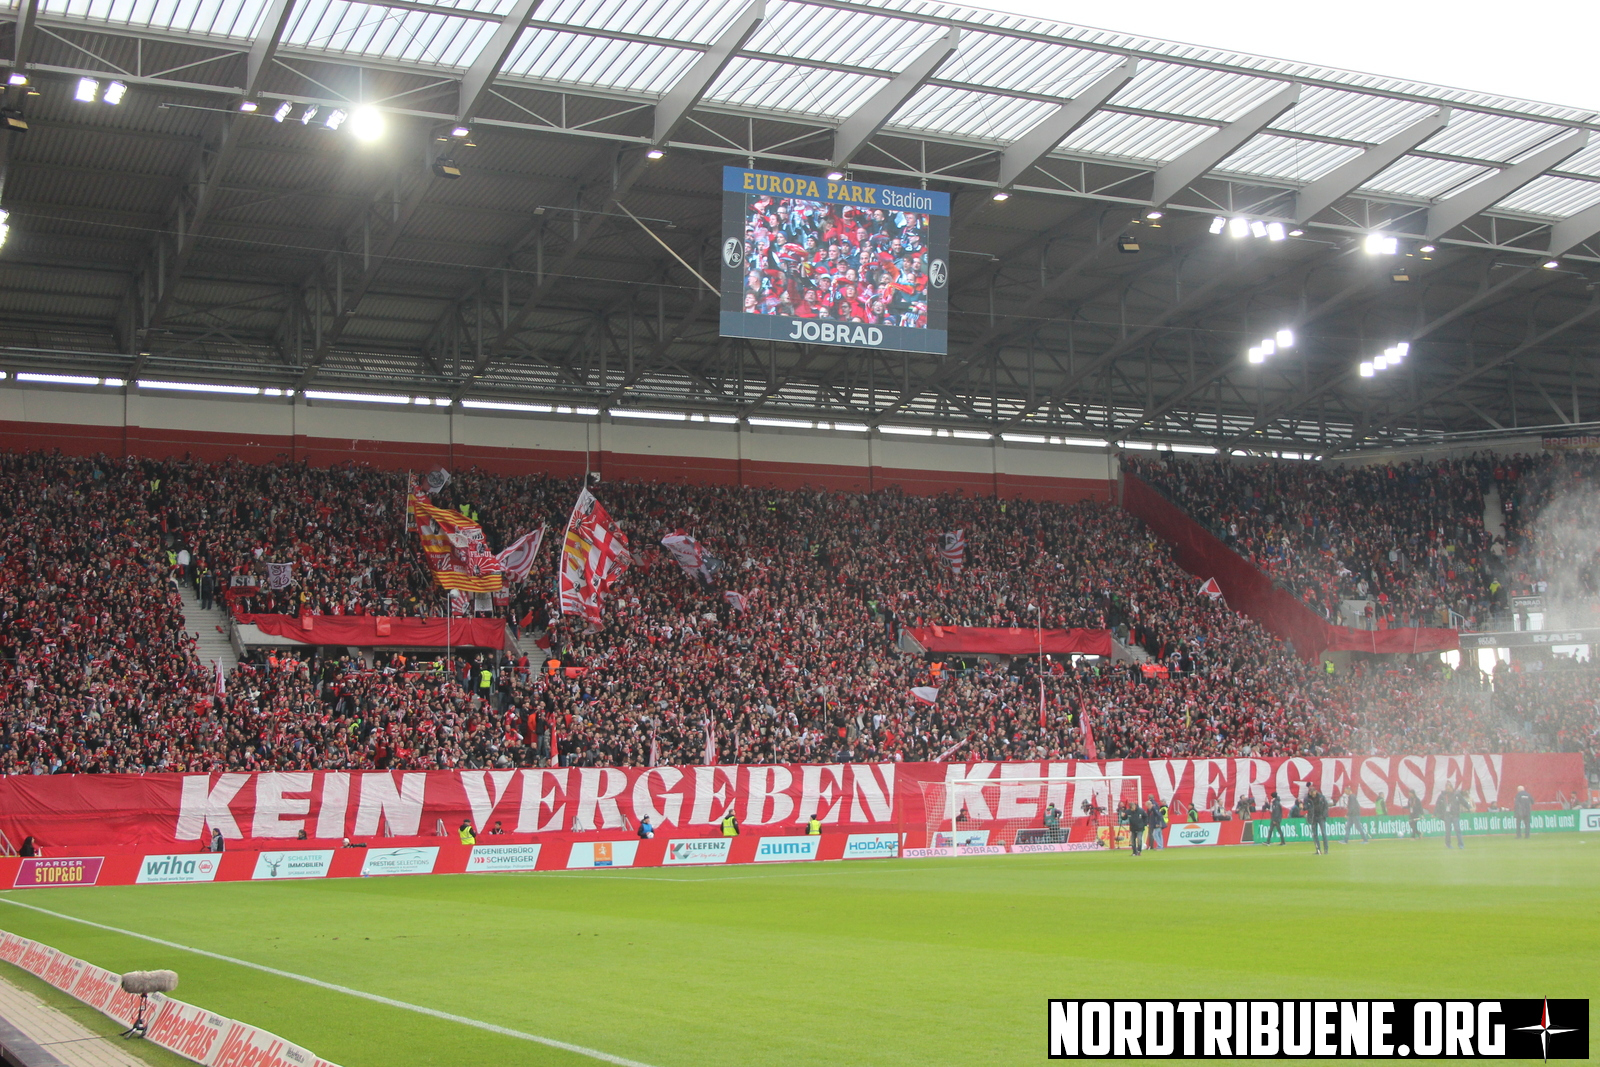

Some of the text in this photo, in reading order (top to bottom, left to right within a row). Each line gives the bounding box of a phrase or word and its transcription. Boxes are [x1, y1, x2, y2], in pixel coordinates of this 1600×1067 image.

[743, 172, 932, 211] EUROPA PARK Stadion
[789, 320, 883, 346] JOBRAD
[174, 754, 1503, 840] KEIN VERGEBEN KEIN VERGESSEN
[1473, 817, 1488, 830] BAU
[1490, 816, 1500, 829] dir
[1530, 815, 1544, 828] Job
[1545, 814, 1557, 828] bei
[1558, 814, 1575, 827] uns!
[1180, 829, 1209, 838] carado
[685, 842, 725, 850] KLEFENZ
[761, 842, 811, 855] auma
[906, 849, 948, 857] JOBRAD
[1019, 845, 1056, 853] JOBRAD
[147, 856, 196, 875] wiha
[486, 855, 534, 863] SCHWEIGER
[35, 866, 83, 882] STOP&GO
[147, 1000, 219, 1061] WeberHaus
